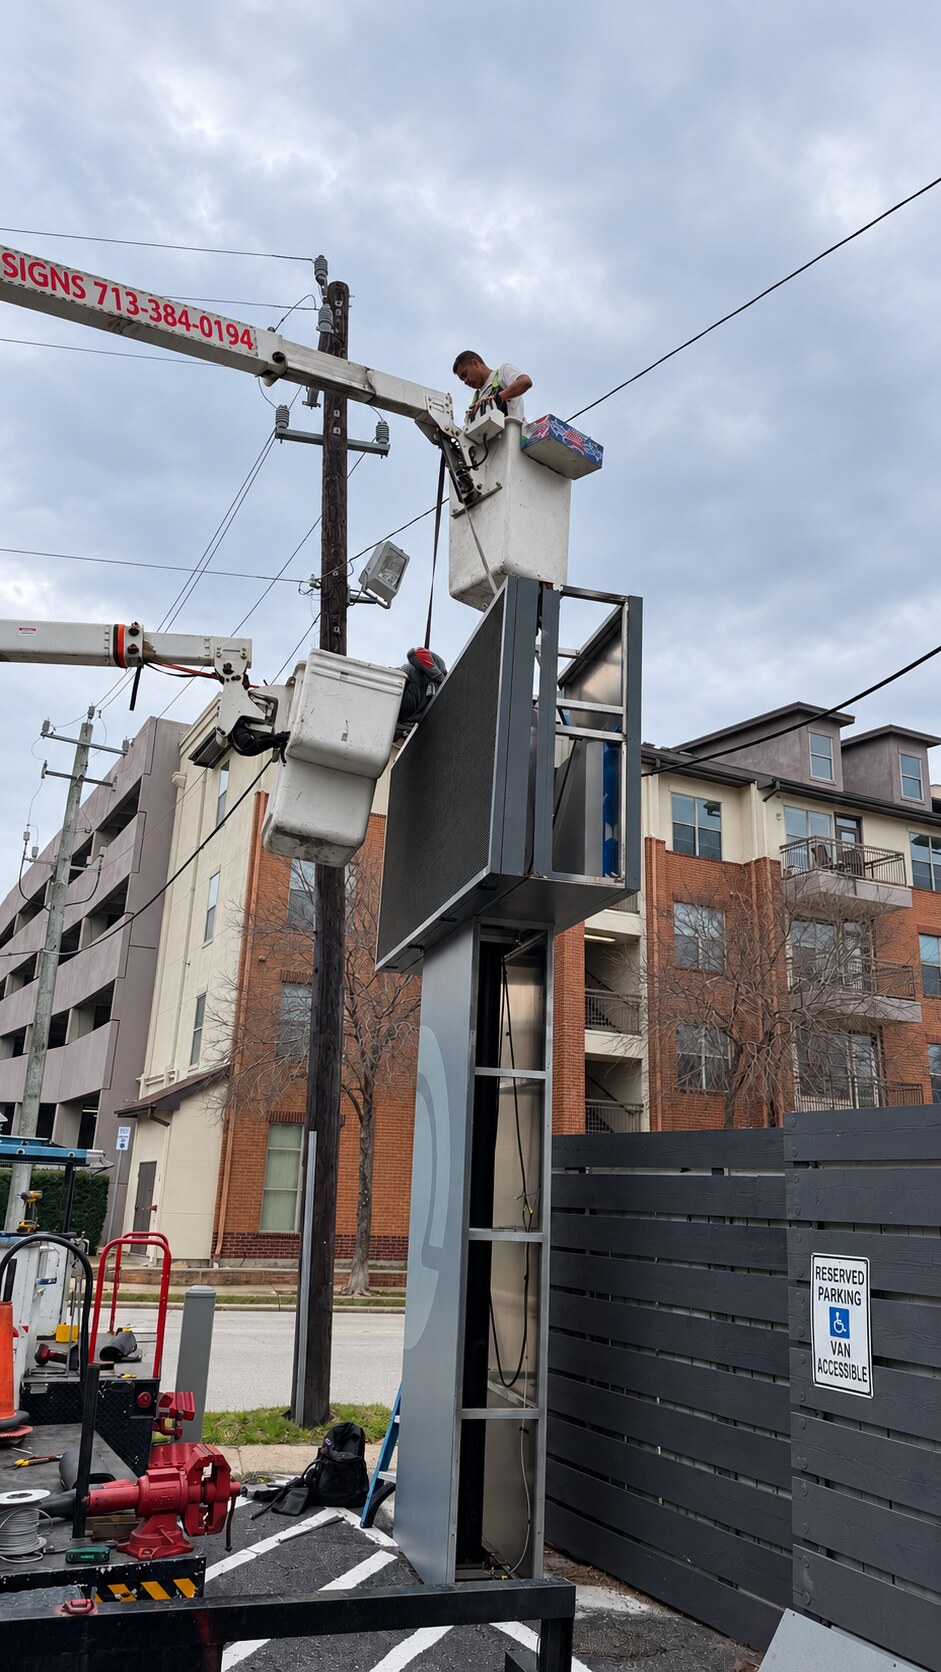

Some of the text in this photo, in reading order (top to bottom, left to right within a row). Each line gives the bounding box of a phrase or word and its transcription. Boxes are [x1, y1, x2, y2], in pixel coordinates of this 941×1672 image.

[1, 252, 254, 350] SIGNS 713-384-0194
[815, 1266, 865, 1286] RESERVED
[818, 1286, 862, 1306] PARKING
[831, 1340, 851, 1358] VAN
[817, 1358, 868, 1383] ACCESSIBLE
